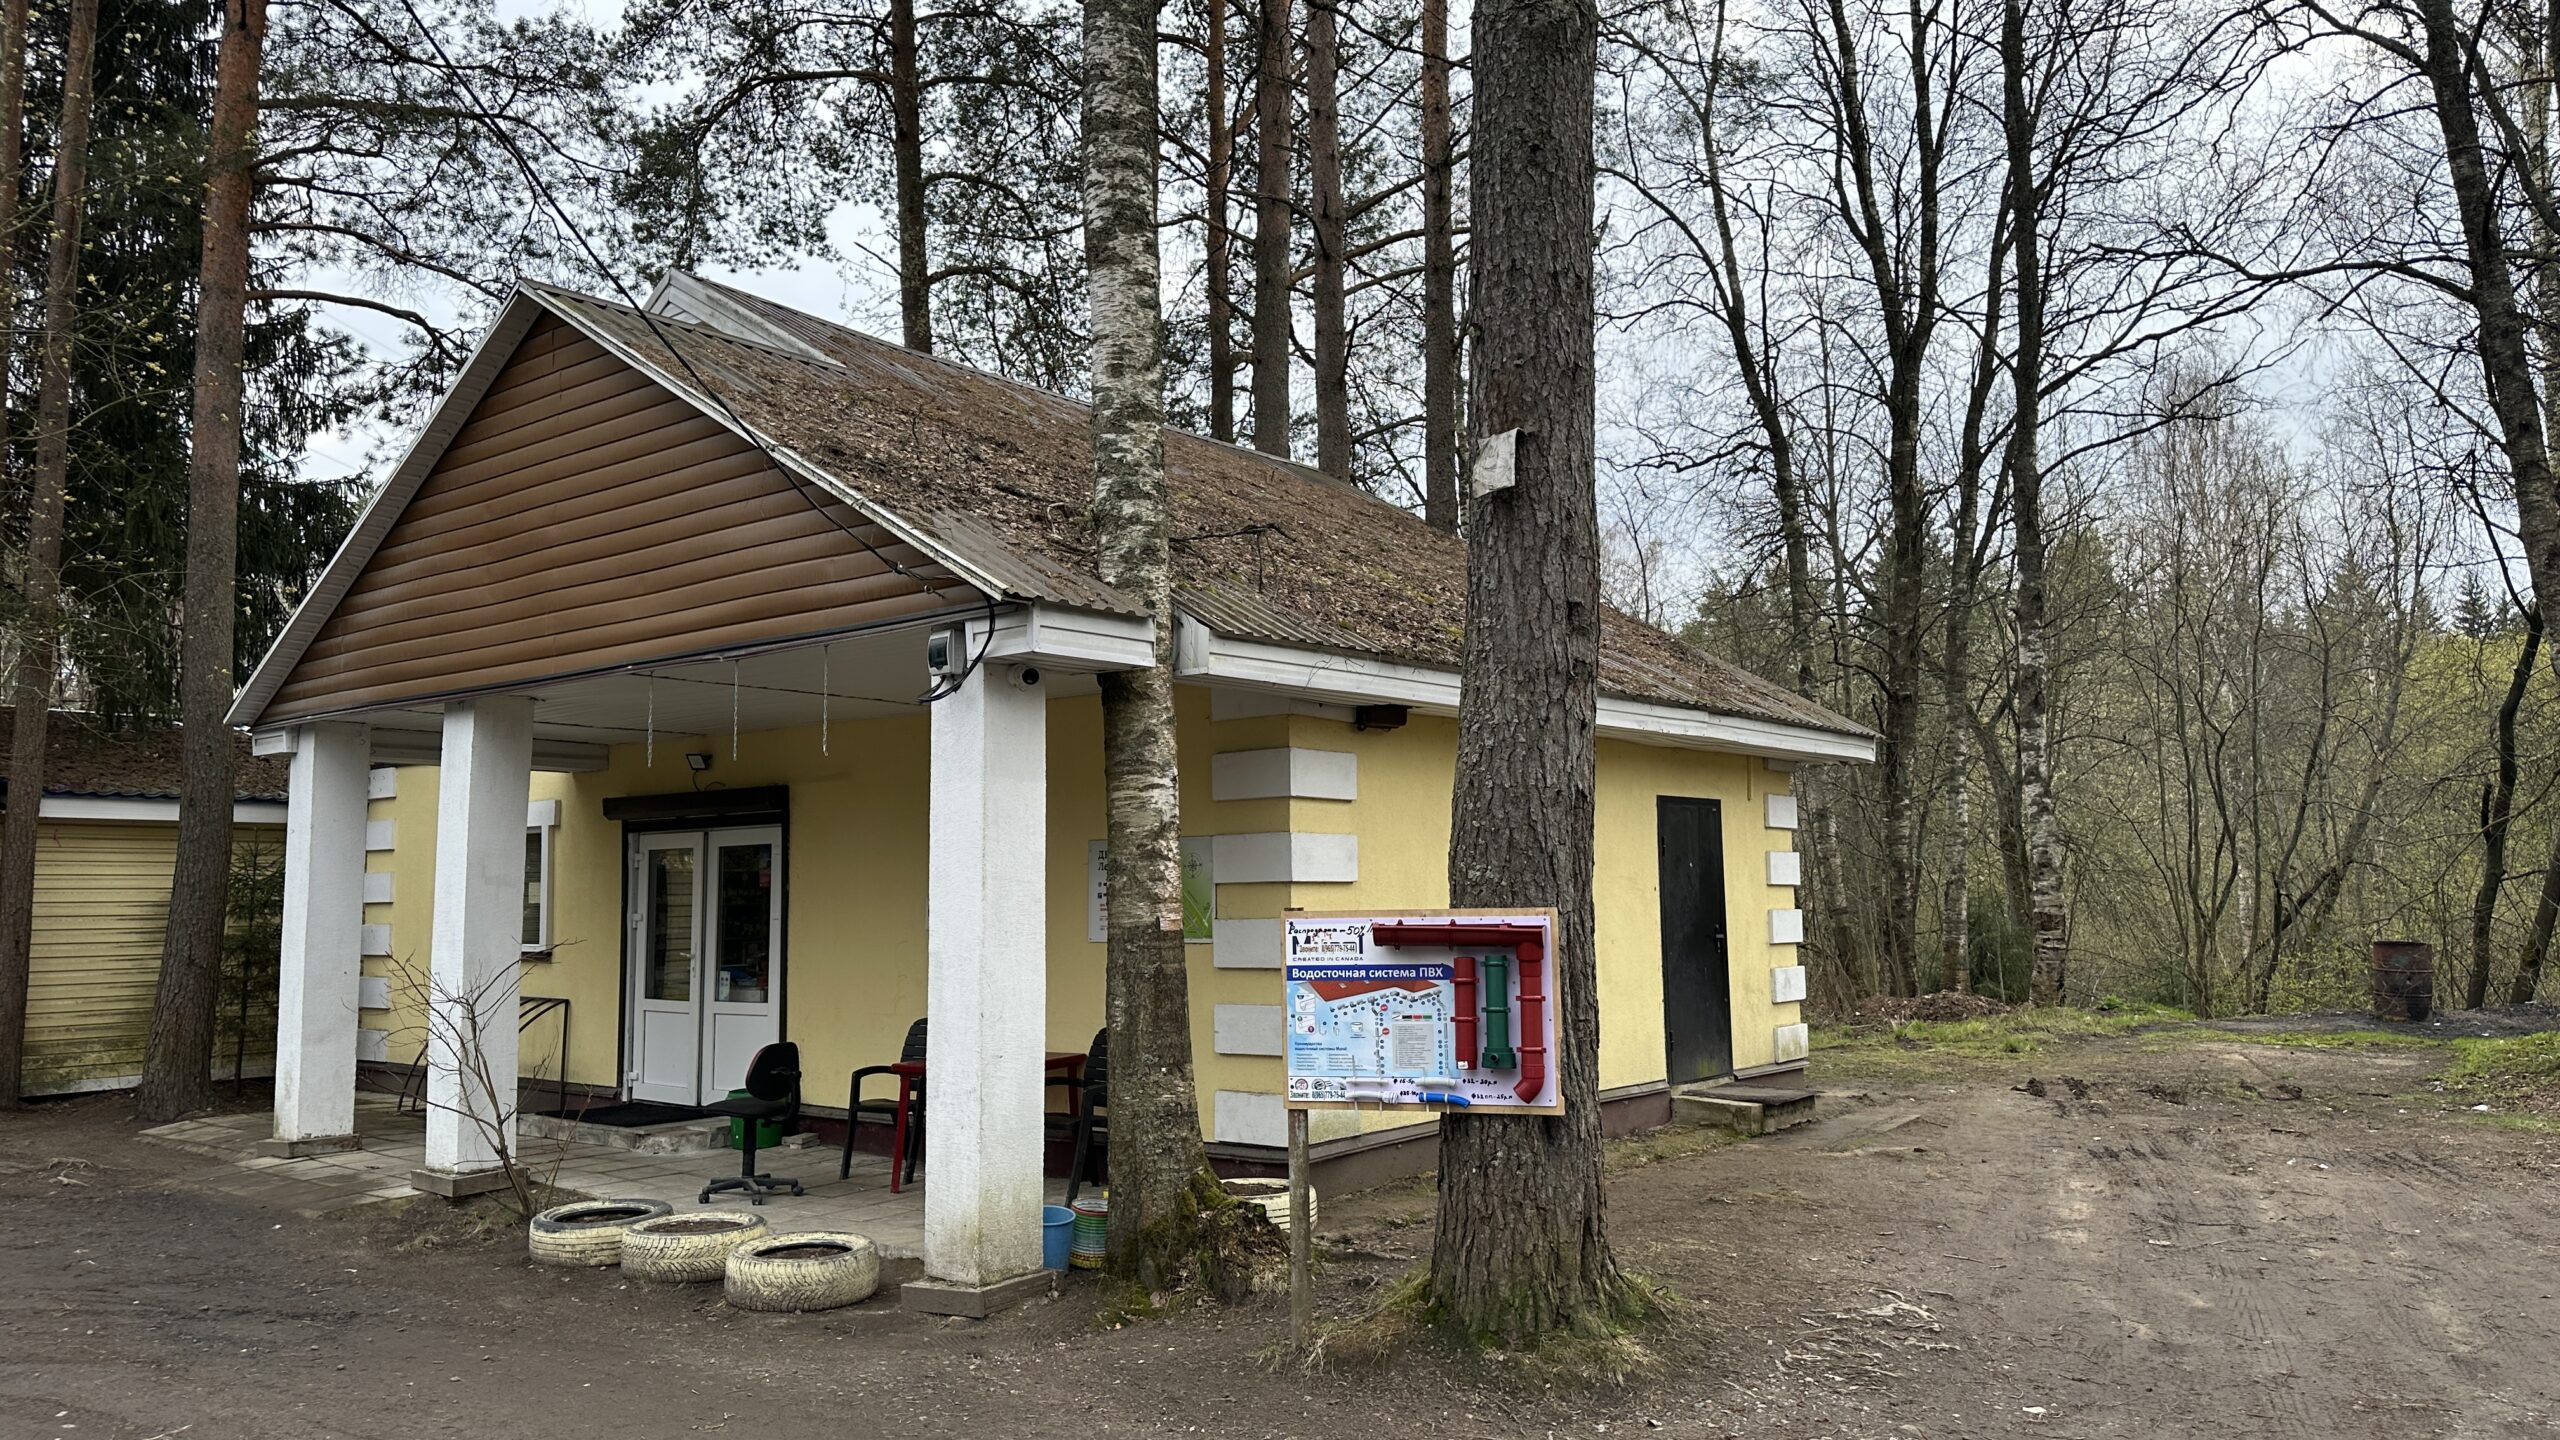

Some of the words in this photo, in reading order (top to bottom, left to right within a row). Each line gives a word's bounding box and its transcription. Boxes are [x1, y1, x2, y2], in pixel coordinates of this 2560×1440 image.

[1292, 968, 1366, 979] Водосточная
[1369, 969, 1416, 978] система
[1419, 967, 1444, 978] ПВХ
